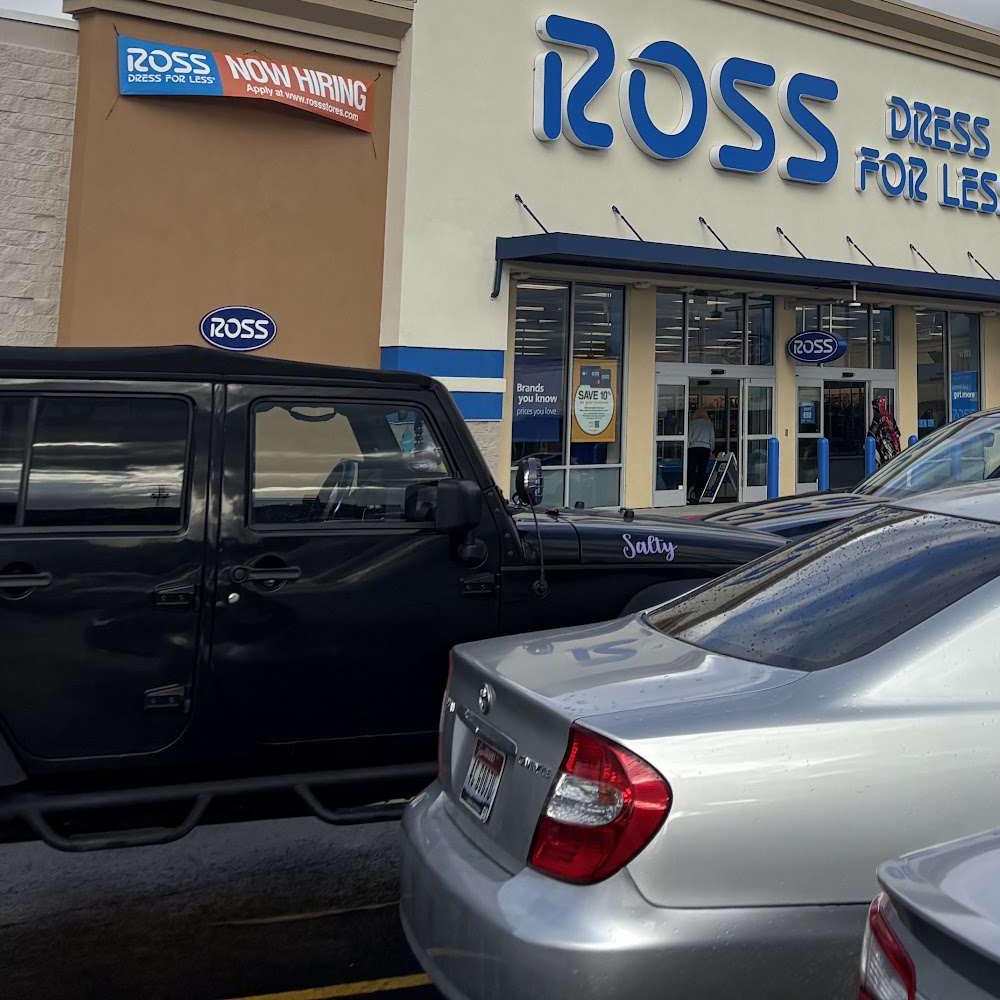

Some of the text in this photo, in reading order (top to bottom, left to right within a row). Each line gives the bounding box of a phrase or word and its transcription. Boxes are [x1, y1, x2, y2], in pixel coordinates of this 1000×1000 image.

[127, 47, 211, 75] ROSS
[128, 74, 162, 83] DRESS
[165, 75, 187, 83] FOR
[225, 54, 368, 112] NOW HIRING
[246, 83, 360, 122] Apply at www.rossstores.com
[534, 14, 839, 184] ROSS
[885, 95, 990, 159] DRESS
[855, 146, 928, 202] FOR
[209, 317, 269, 340] ROSS
[793, 338, 834, 355] ROSS
[516, 383, 545, 393] Brands
[518, 393, 557, 405] you know
[578, 390, 598, 400] SAVE
[516, 407, 557, 417] prices you love
[622, 533, 678, 562] Salty
